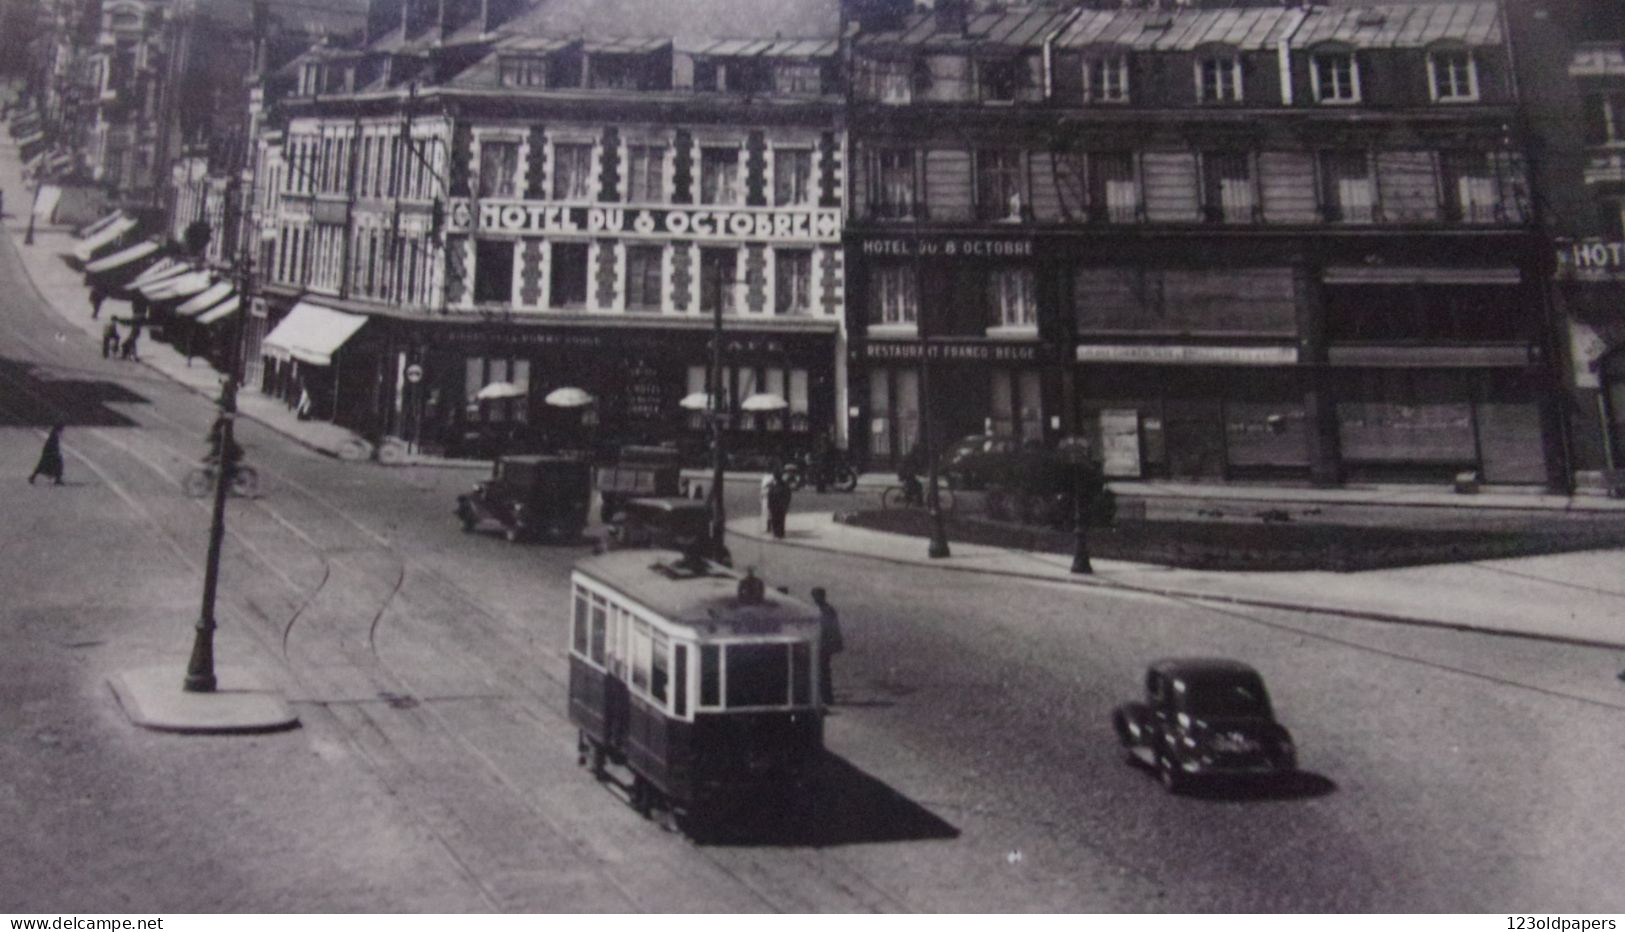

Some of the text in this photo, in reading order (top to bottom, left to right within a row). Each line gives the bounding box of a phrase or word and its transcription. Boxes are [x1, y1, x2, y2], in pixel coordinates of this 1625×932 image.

[479, 204, 578, 231] HOTEL
[586, 206, 624, 232] DU
[665, 209, 809, 238] OCTOBRE
[863, 240, 909, 255] HOTEL
[945, 241, 956, 255] 8
[962, 241, 1032, 255] OCTOBRE
[943, 346, 988, 359] FRANCO
[995, 347, 1035, 360] BELGE
